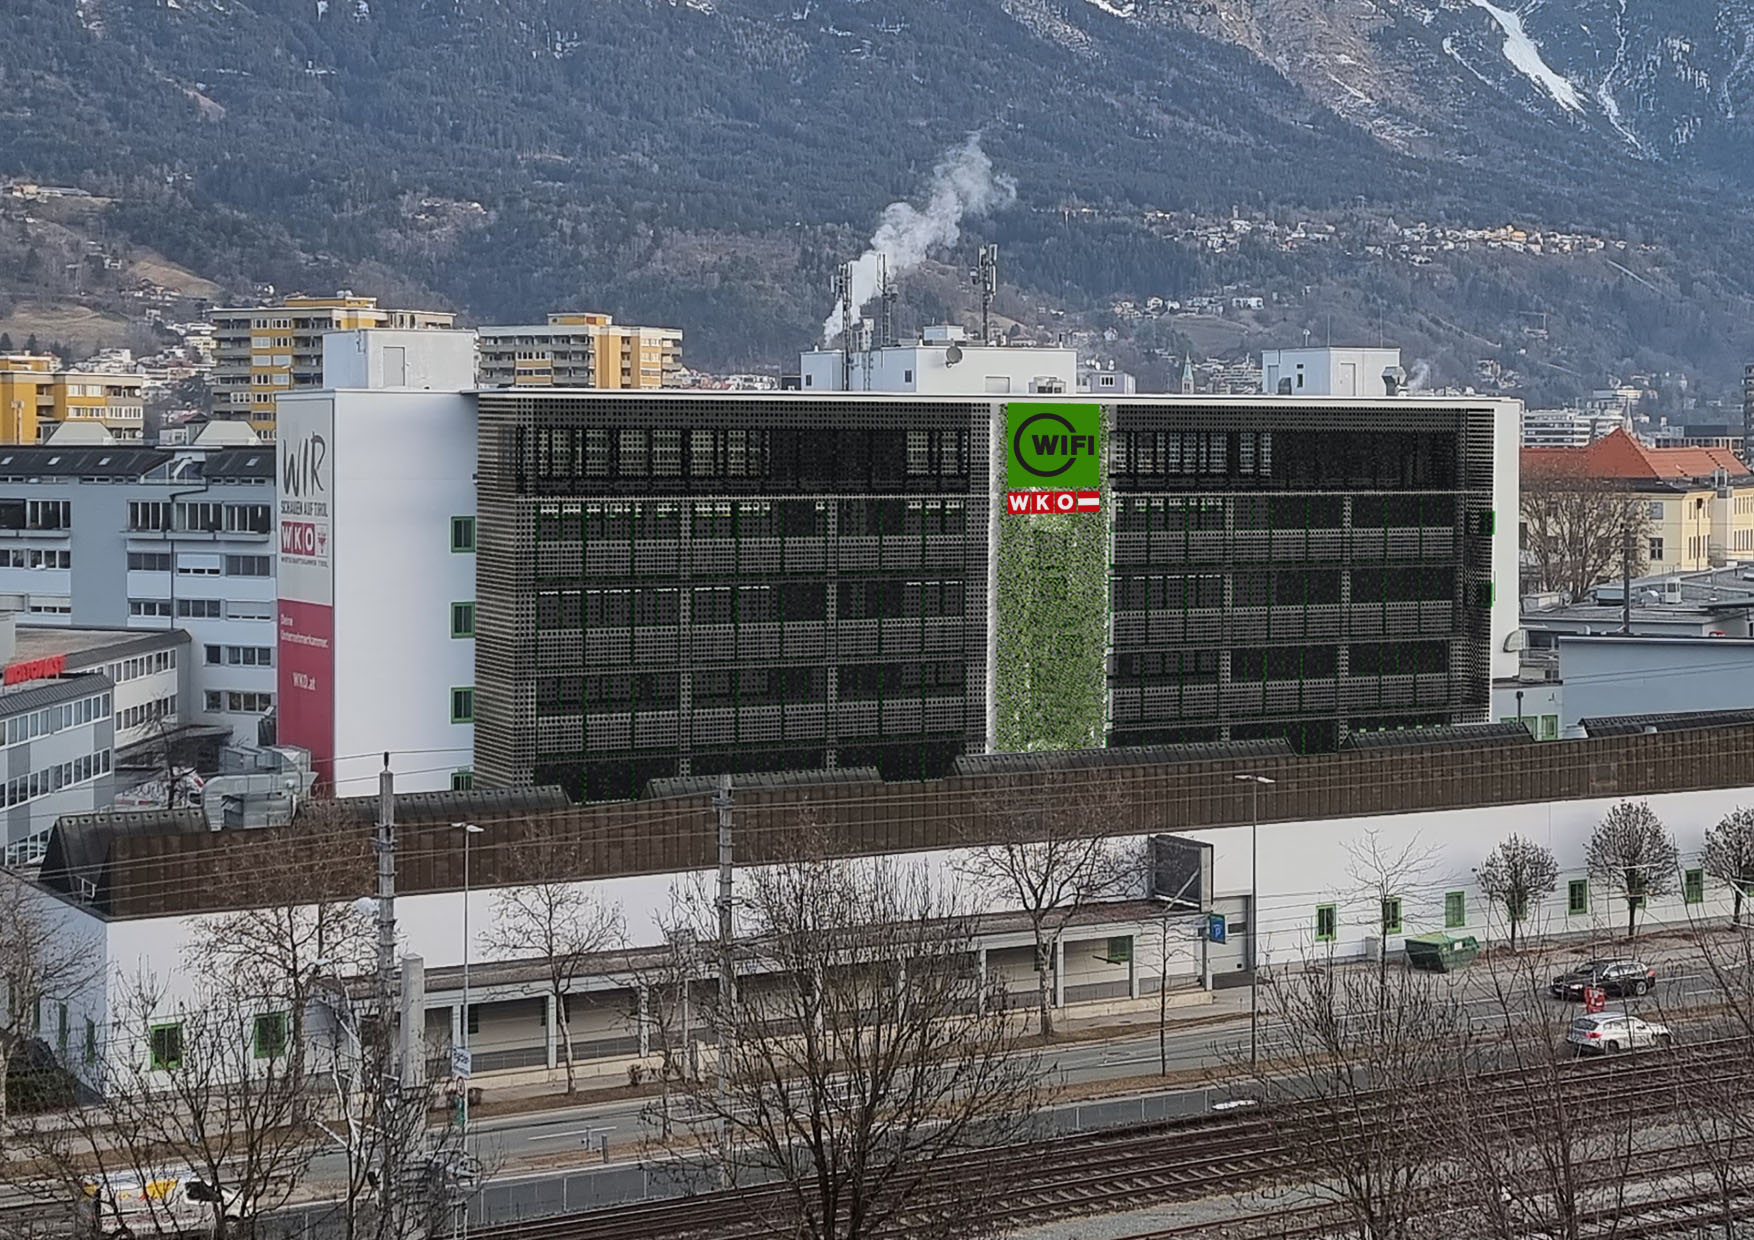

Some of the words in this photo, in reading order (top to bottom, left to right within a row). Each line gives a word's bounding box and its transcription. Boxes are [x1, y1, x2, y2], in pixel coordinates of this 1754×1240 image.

[1031, 434, 1095, 456] WIFI
[283, 431, 326, 497] WIR
[1009, 494, 1074, 511] WKO
[281, 525, 314, 552] WKO
[292, 671, 316, 691] WKO.at
